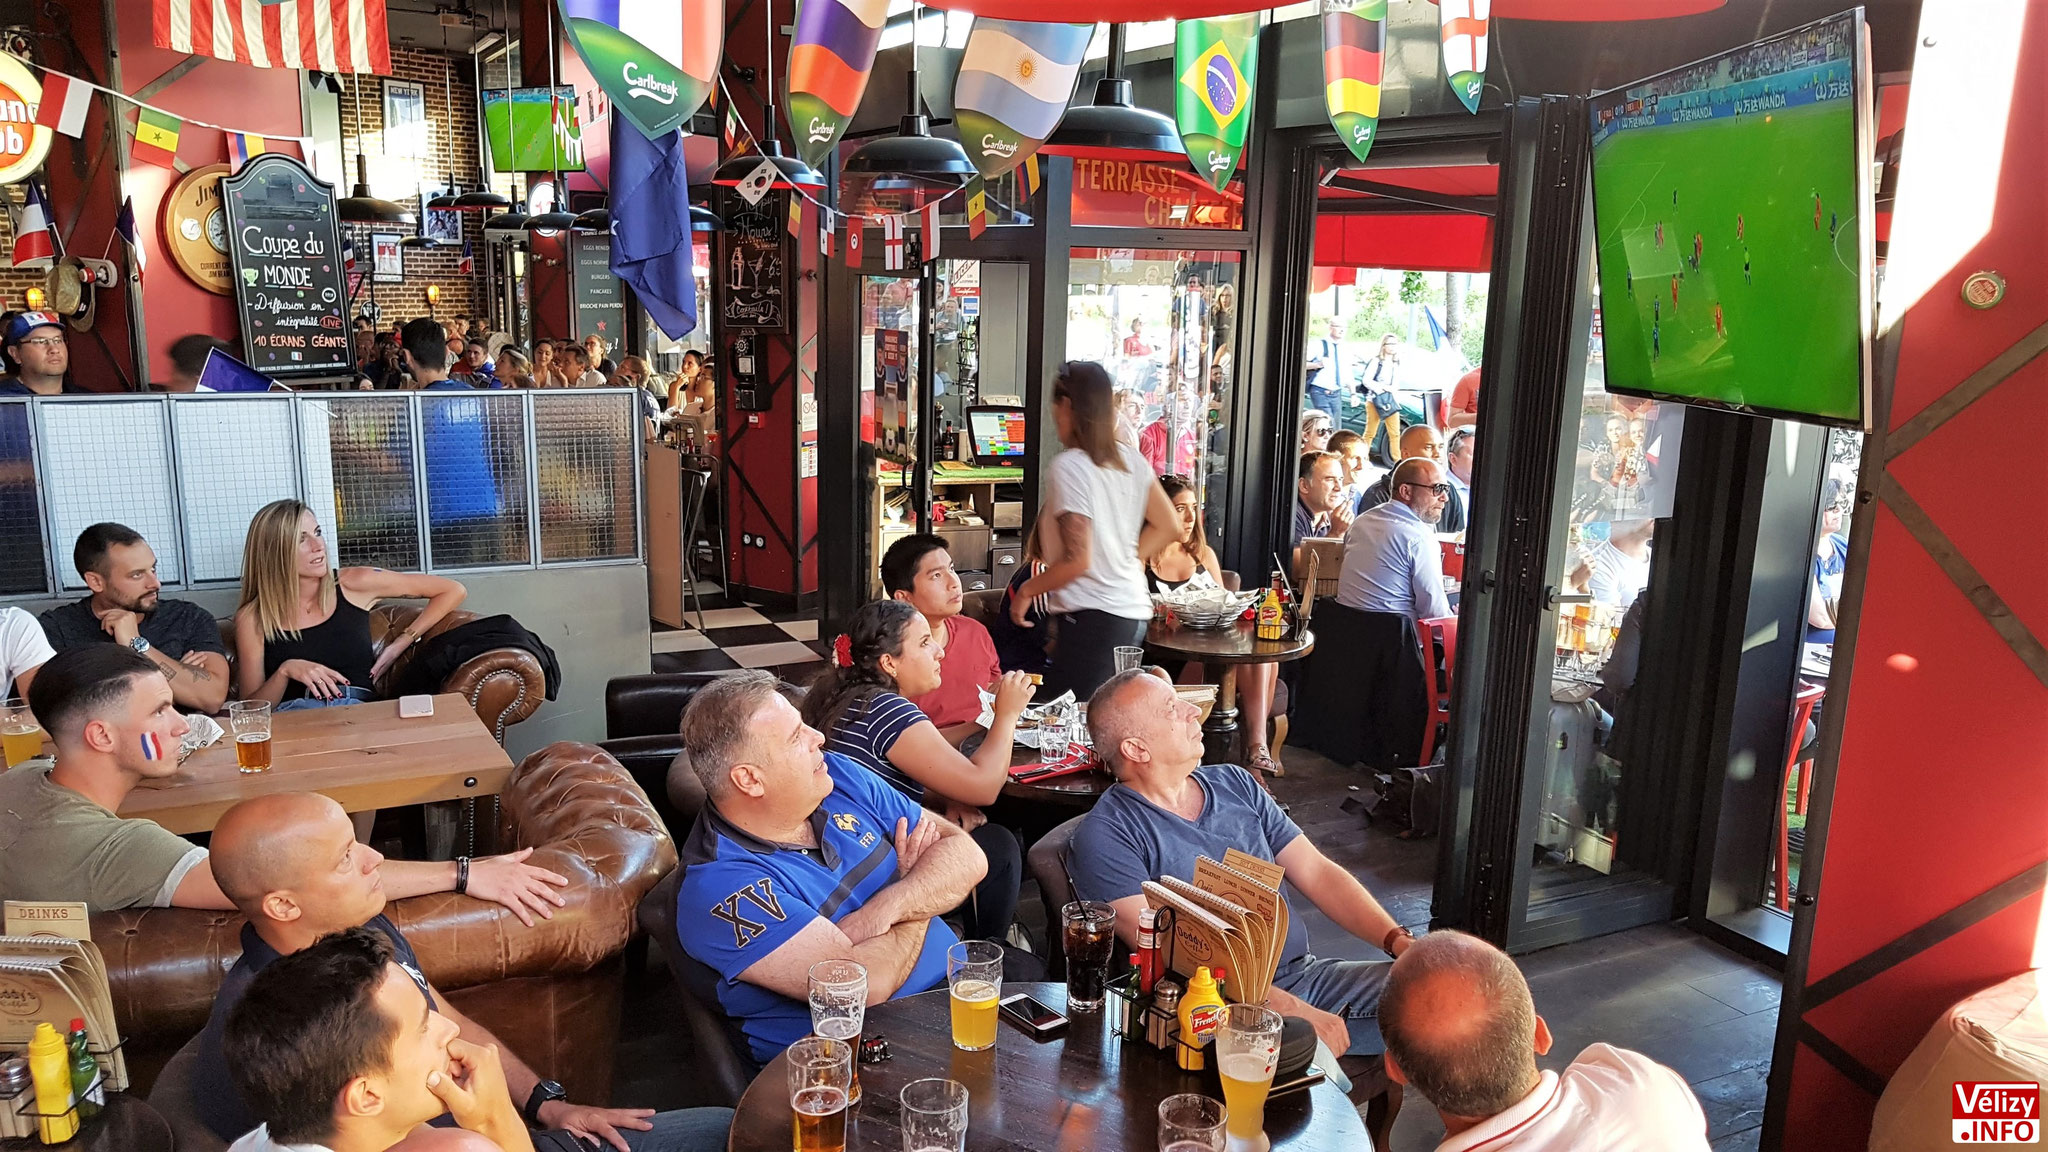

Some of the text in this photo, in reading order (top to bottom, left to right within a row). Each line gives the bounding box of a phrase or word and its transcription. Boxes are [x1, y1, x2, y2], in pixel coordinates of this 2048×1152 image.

[623, 62, 679, 100] Carlbreak
[982, 134, 1018, 154] Carlbreak
[1077, 159, 1180, 194] TERRASSE
[242, 226, 324, 260] Coupe du
[264, 264, 312, 287] MONDE
[322, 320, 341, 328] LIVE
[254, 333, 347, 347] 10 ÉCRANS GÉANTS
[859, 831, 876, 848] FFR
[20, 909, 68, 919] DRINKS
[710, 878, 787, 948] XV
